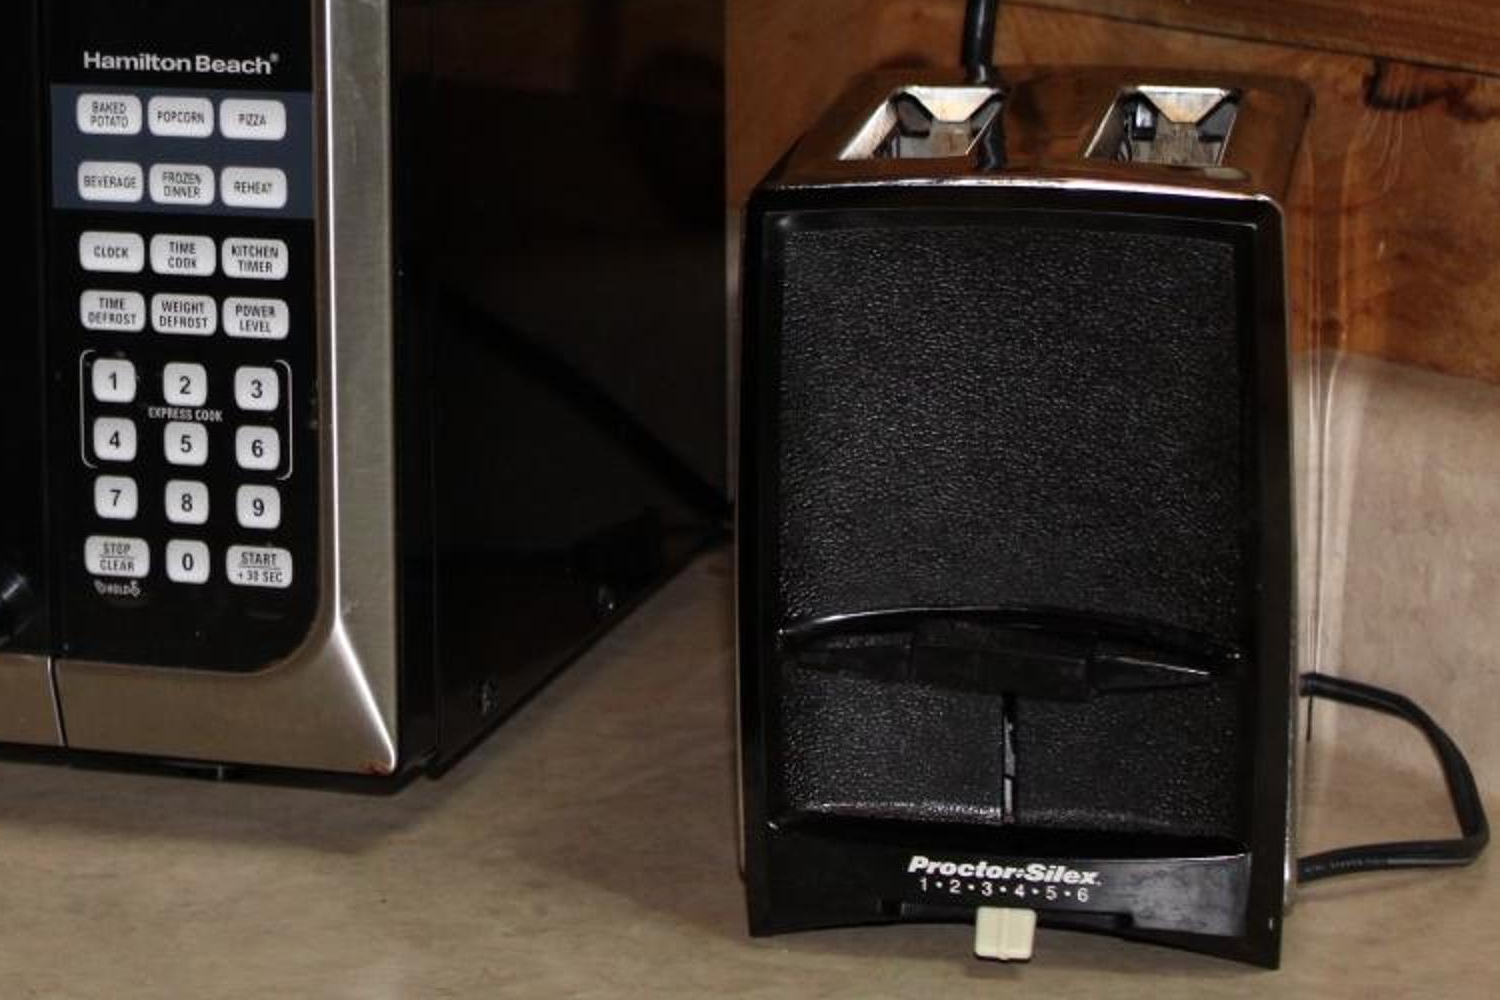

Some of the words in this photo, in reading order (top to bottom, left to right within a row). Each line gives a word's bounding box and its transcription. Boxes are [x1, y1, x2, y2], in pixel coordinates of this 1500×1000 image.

[83, 51, 191, 73] Hamilton
[91, 101, 127, 115] BAKED
[90, 115, 129, 129] POTATO
[157, 110, 205, 125] POPCORN
[238, 114, 267, 127] PIZZA
[83, 175, 138, 189] BEVERAGE
[162, 171, 202, 185] FROZEN
[163, 185, 201, 199] DINNER
[234, 181, 273, 195] REHEAT
[93, 245, 129, 259] CLOCK
[169, 240, 196, 255] TIME
[231, 244, 279, 259] KITCHEN
[167, 256, 197, 270] COOK
[238, 259, 273, 273] TIMER
[99, 297, 126, 311] TIME
[161, 300, 205, 315] WEIGHT
[235, 304, 276, 318] POWER
[87, 311, 137, 326] DEFROST
[159, 314, 209, 329] DEFROST
[239, 319, 272, 334] LEVEL
[107, 372, 118, 390] 1
[179, 376, 192, 395] 2
[250, 380, 263, 399] 3
[147, 406, 193, 421] EXPRESS
[194, 408, 223, 422] COOK
[108, 430, 121, 449] 4
[180, 435, 192, 453] 5
[251, 439, 264, 458] 6
[110, 489, 122, 507] 7
[180, 493, 193, 512] 8
[252, 498, 265, 517] 9
[103, 542, 131, 556] STOP
[99, 558, 135, 573] CLEAR
[181, 552, 194, 571] 0
[240, 552, 276, 566] START
[262, 570, 283, 583] SEC
